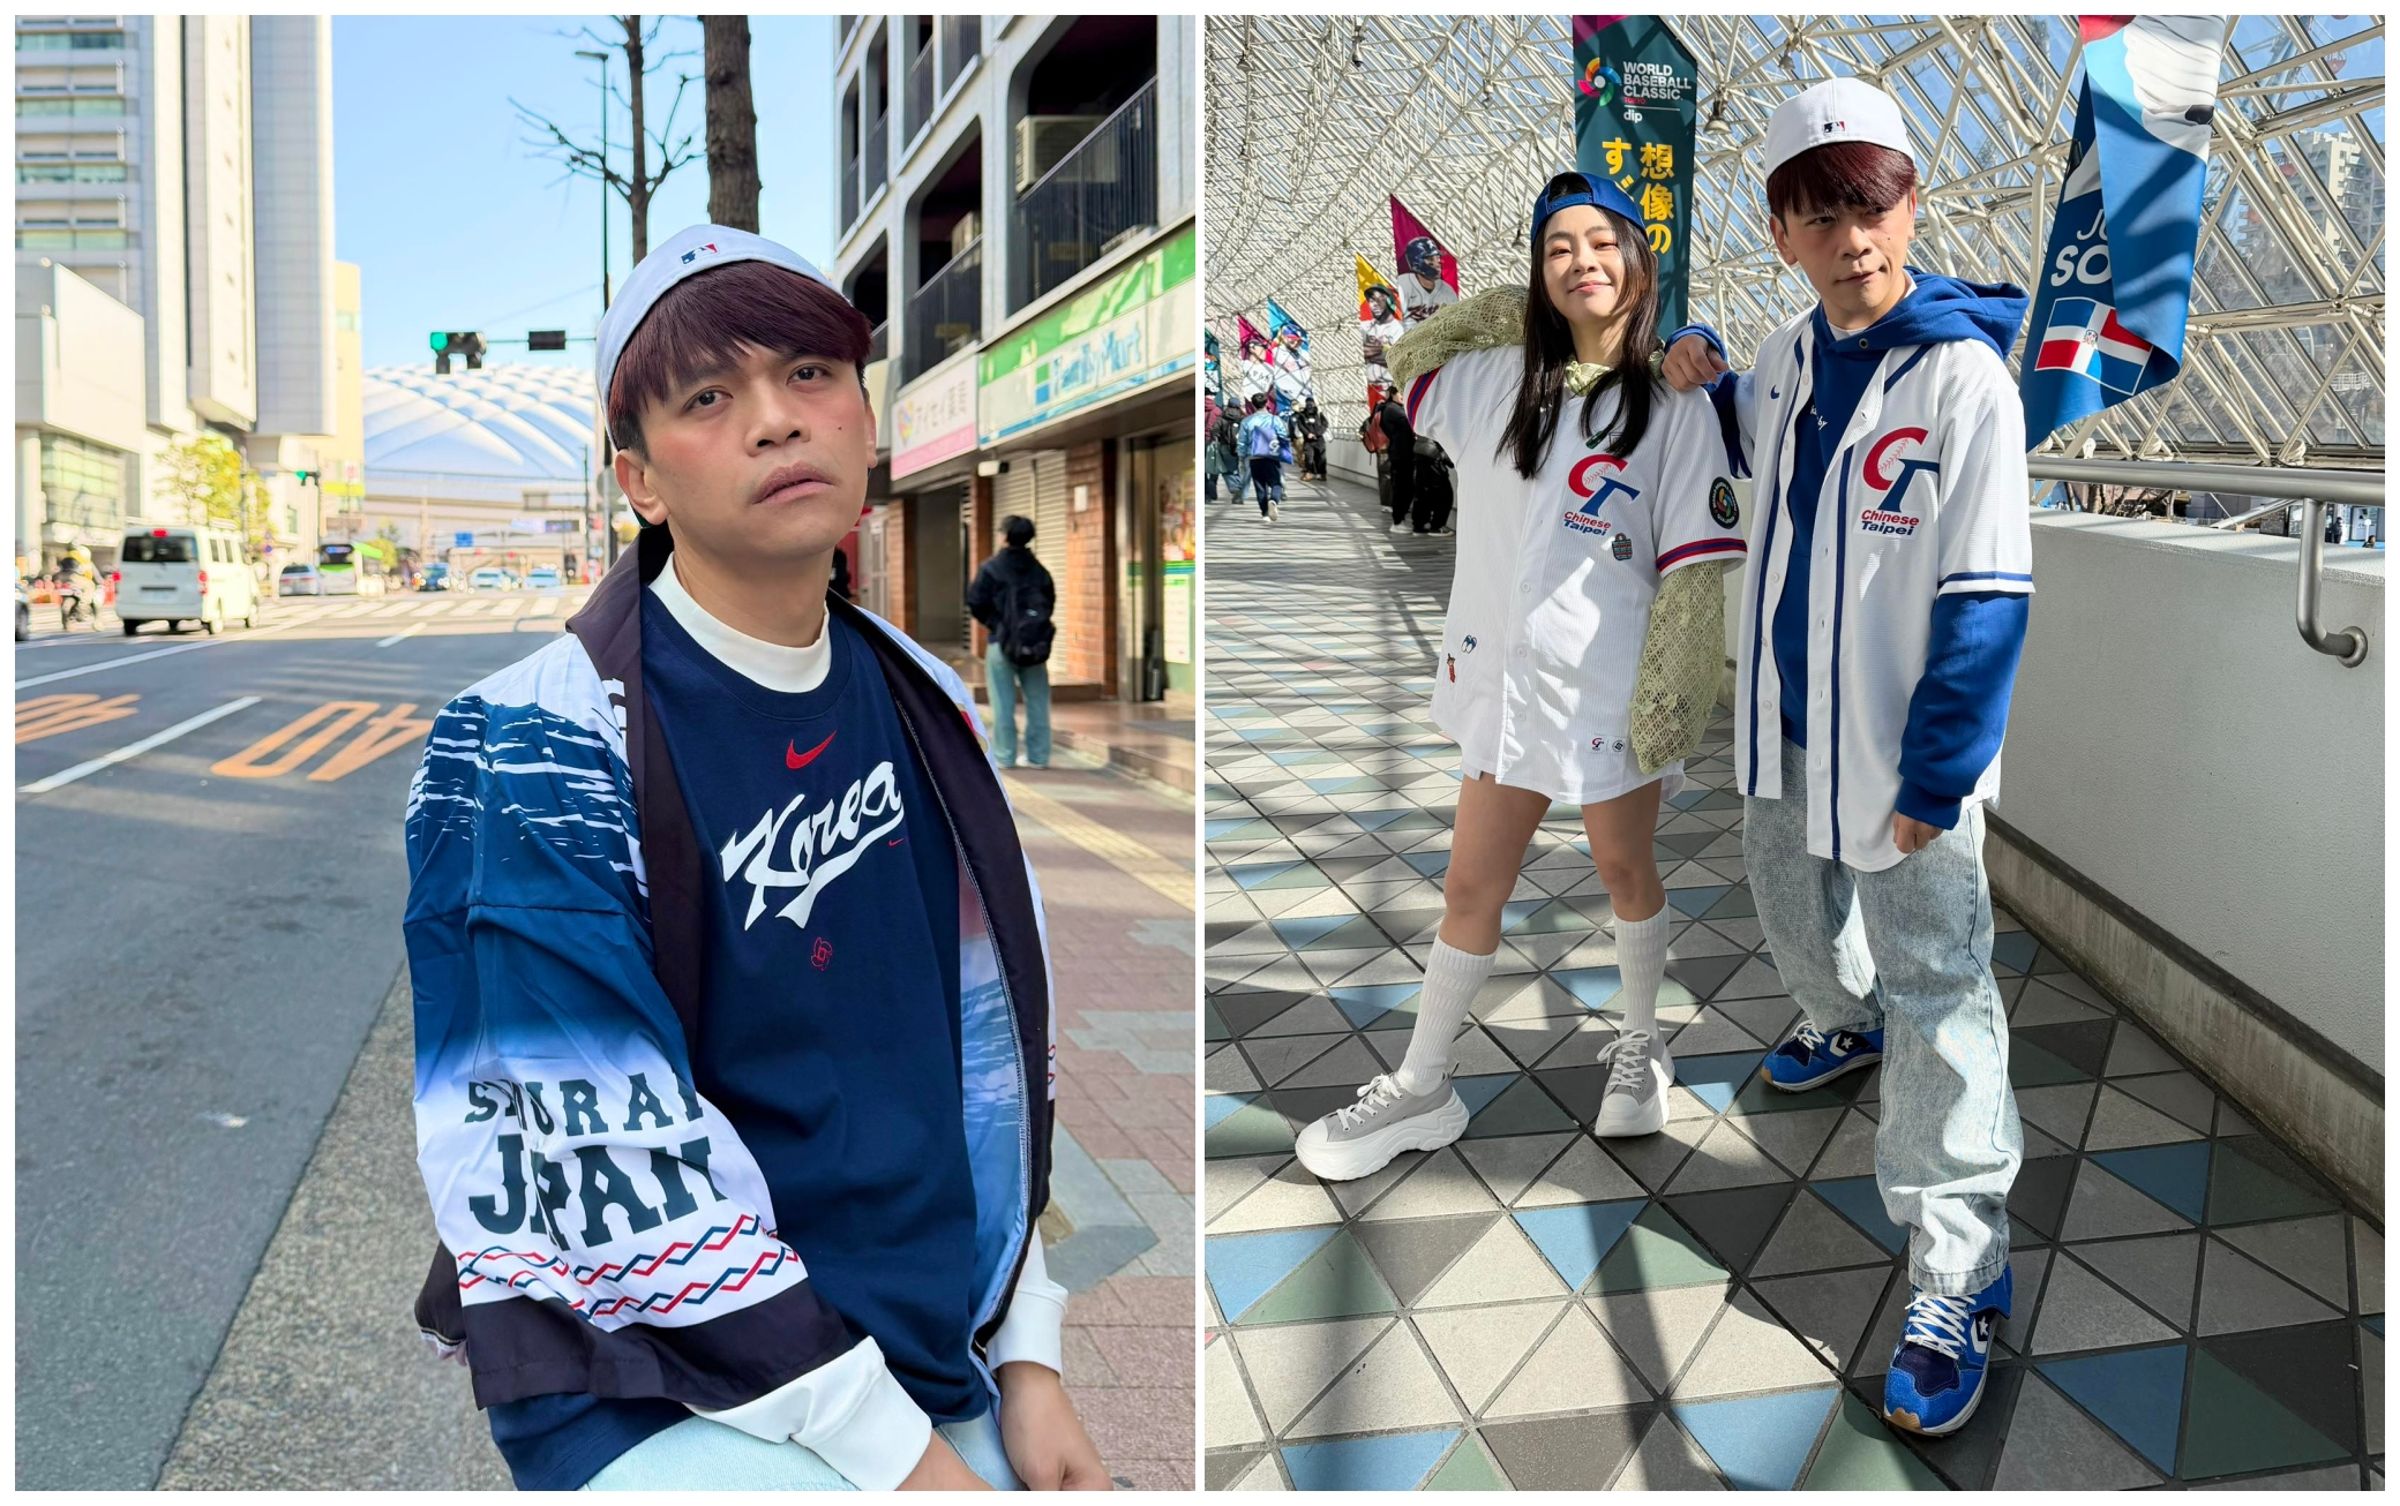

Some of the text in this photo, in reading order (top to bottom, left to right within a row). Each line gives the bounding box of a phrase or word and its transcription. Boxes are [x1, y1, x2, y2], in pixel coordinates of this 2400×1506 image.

[1623, 61, 1673, 77] WORLD
[1623, 73, 1692, 90] BASEBALL
[1623, 109, 1643, 124] dip
[1639, 142, 1675, 254] 想像の
[1563, 511, 1612, 530] Chinese
[1861, 509, 1920, 526] Chinese
[1563, 518, 1607, 537] Taipei
[1861, 520, 1914, 536] Taipei
[720, 761, 904, 931] Korea
